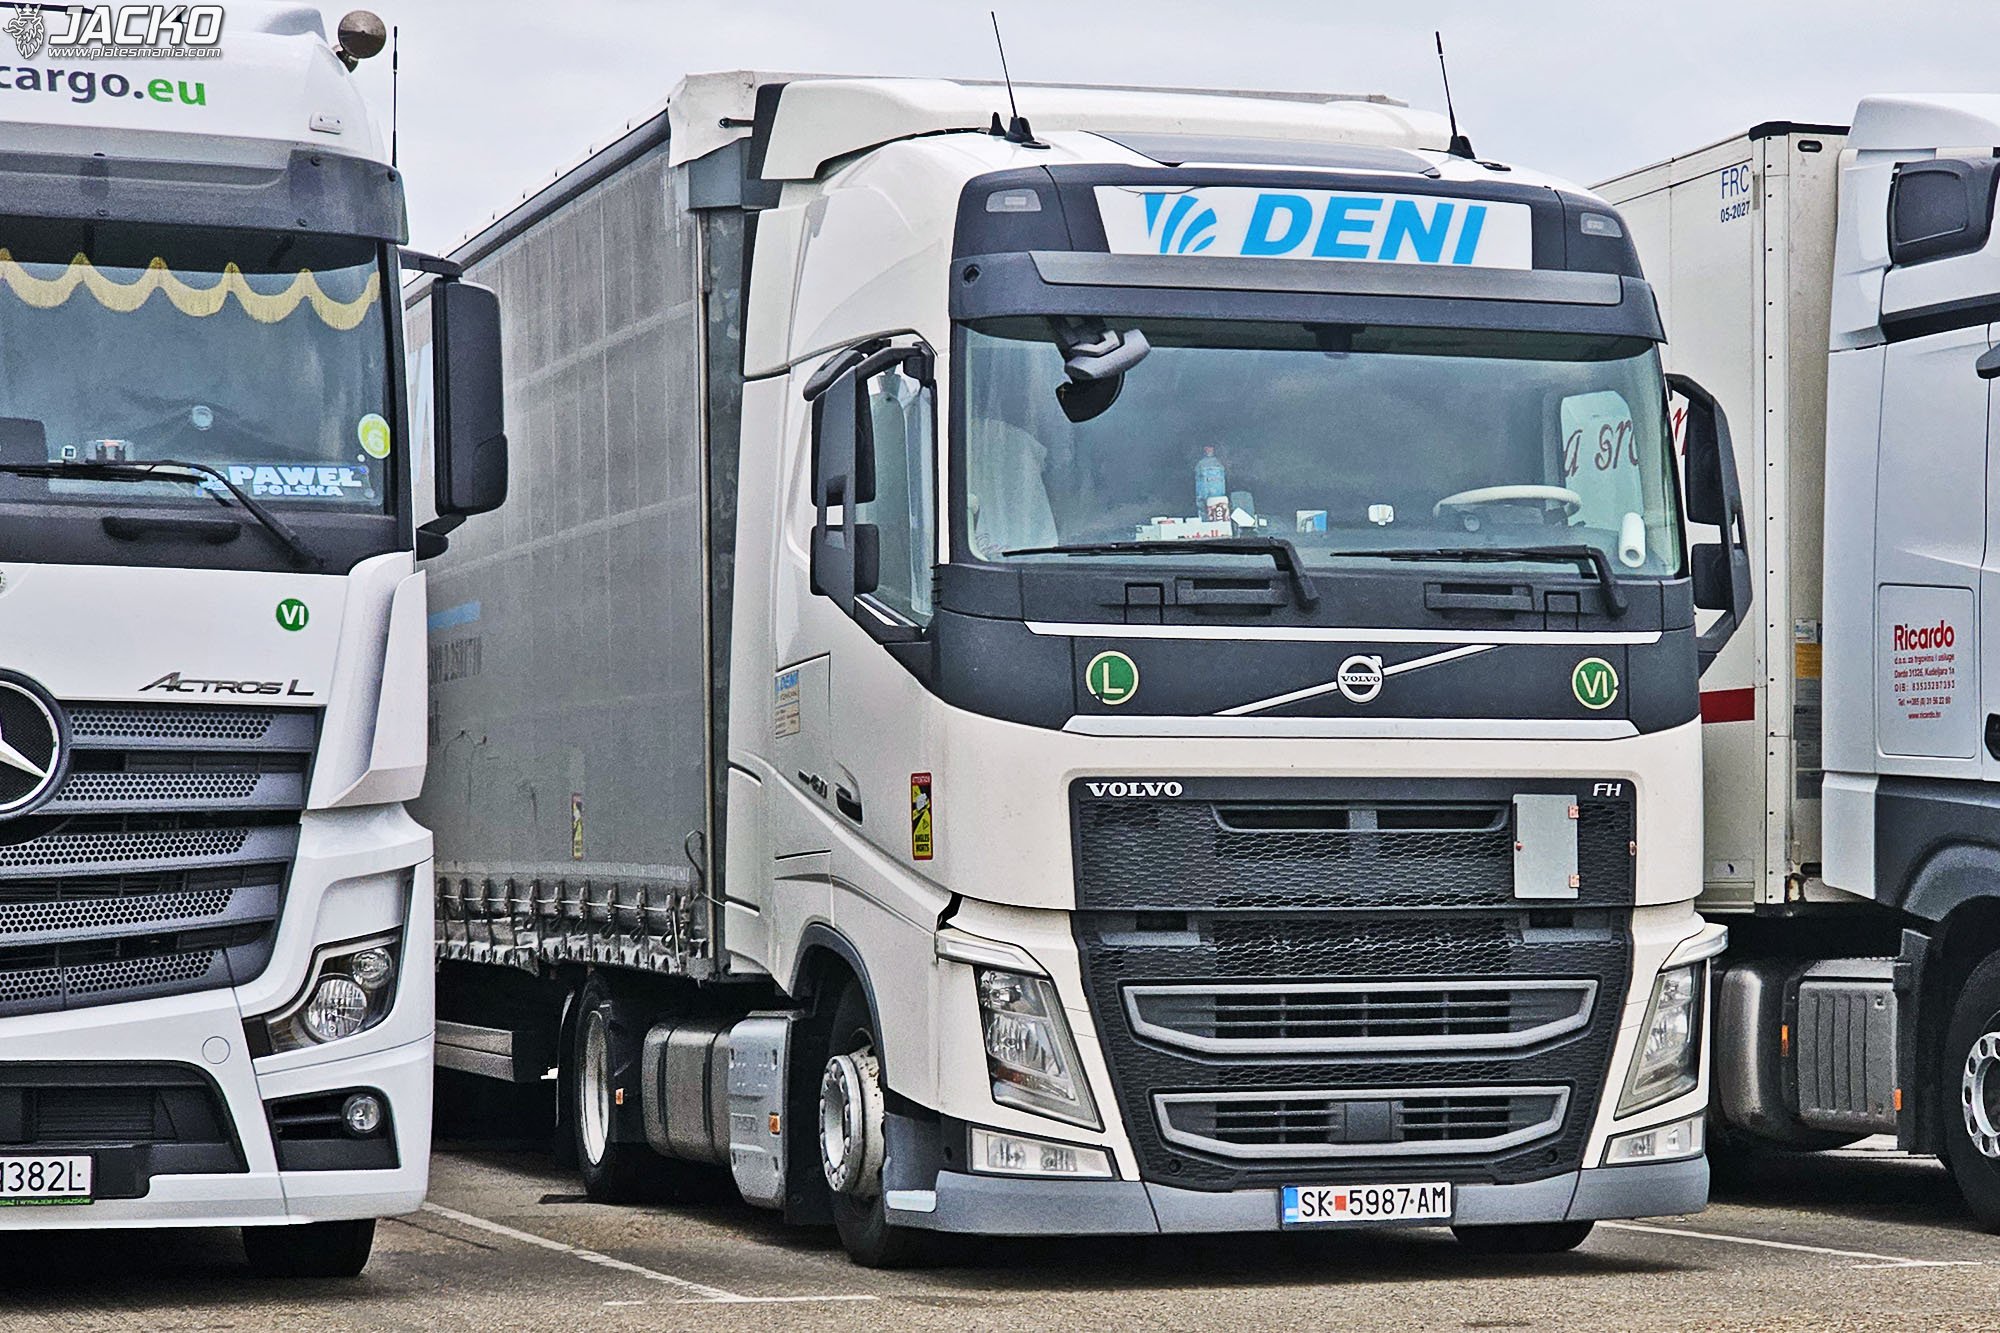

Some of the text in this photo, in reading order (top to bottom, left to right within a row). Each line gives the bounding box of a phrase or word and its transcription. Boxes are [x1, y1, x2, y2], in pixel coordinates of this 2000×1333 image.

[1721, 165, 1749, 199] FRC
[1720, 200, 1750, 223] 05-2027
[1241, 193, 1487, 265] DENI
[228, 466, 362, 487] PAWEŁ
[253, 485, 344, 496] POLSKA
[281, 605, 306, 626] VI
[1894, 620, 1955, 651] Ricardo
[286, 679, 315, 696] L
[1103, 663, 1124, 695] L
[1341, 675, 1381, 683] VOLVO
[1582, 669, 1611, 698] VI
[1086, 782, 1623, 798] VOLVO FH
[1301, 1186, 1447, 1217] SK 5987 AM
